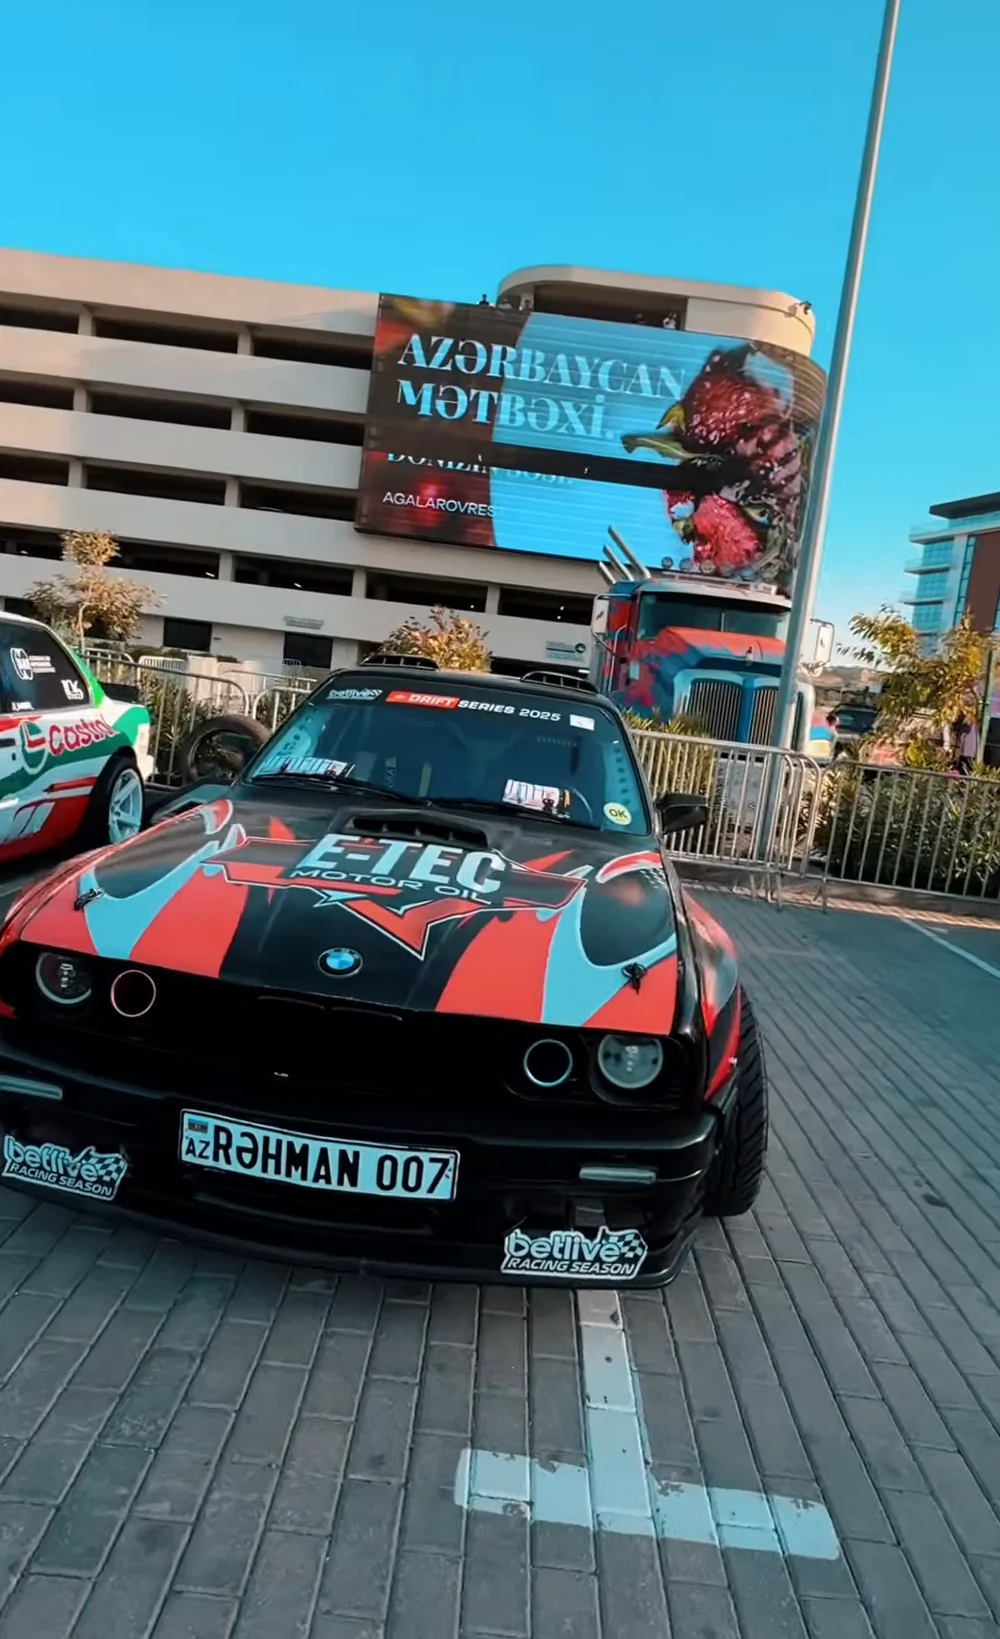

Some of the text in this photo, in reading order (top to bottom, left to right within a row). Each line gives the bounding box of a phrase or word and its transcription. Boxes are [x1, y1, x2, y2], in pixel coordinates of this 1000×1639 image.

[397, 333, 685, 400] AZƏRBAYCAN
[408, 693, 561, 721] DRIFT SERIES 2025
[608, 808, 628, 819] OK
[295, 833, 506, 894] E-TEC
[289, 868, 491, 905] MOTOR OIL
[7, 1138, 99, 1182] betlive
[185, 1137, 210, 1160] AZ
[212, 1124, 450, 1194] RƏHMAN 007
[9, 1162, 113, 1196] RACING SEASON
[508, 1231, 621, 1263] betlive
[507, 1257, 635, 1275] RACING SEASON
